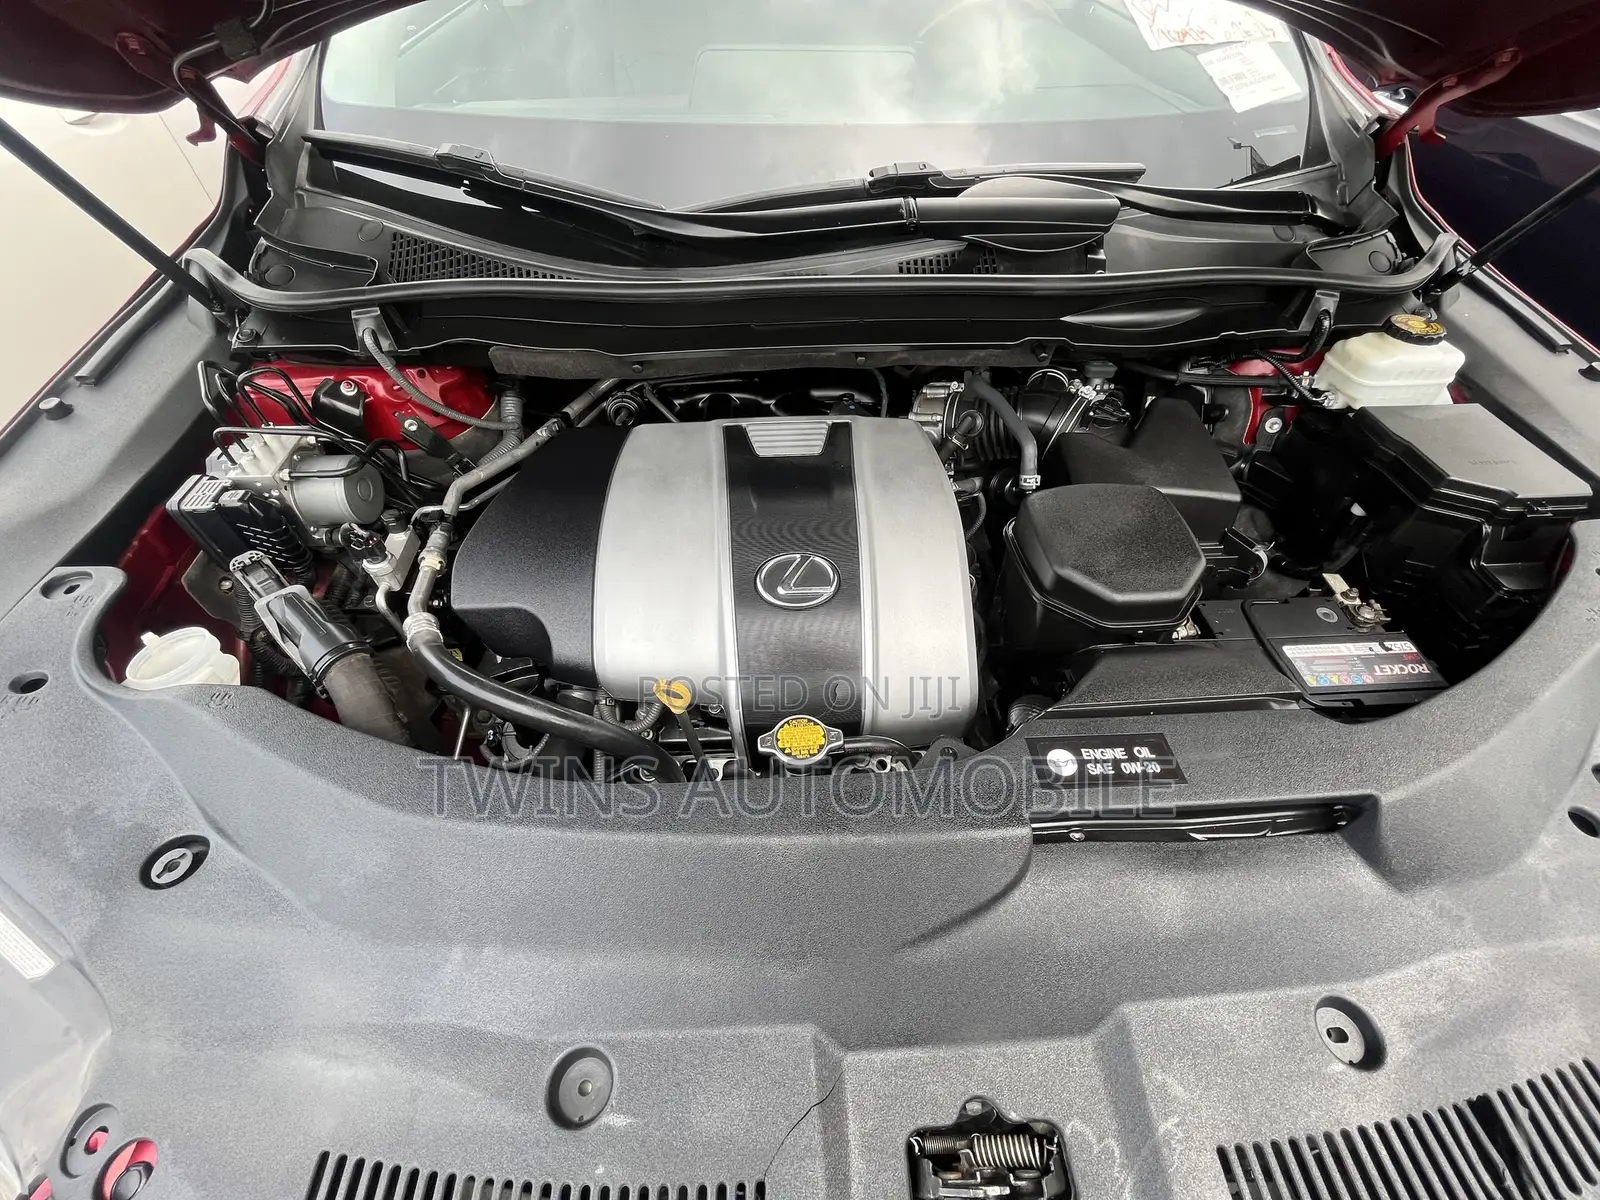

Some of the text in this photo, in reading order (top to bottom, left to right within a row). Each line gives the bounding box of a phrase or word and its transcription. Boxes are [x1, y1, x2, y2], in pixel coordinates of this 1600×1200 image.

[1373, 663, 1431, 675] ROCKET
[1080, 746, 1156, 760] ENGINE OIL
[1086, 761, 1161, 775] SAE 0W-20
